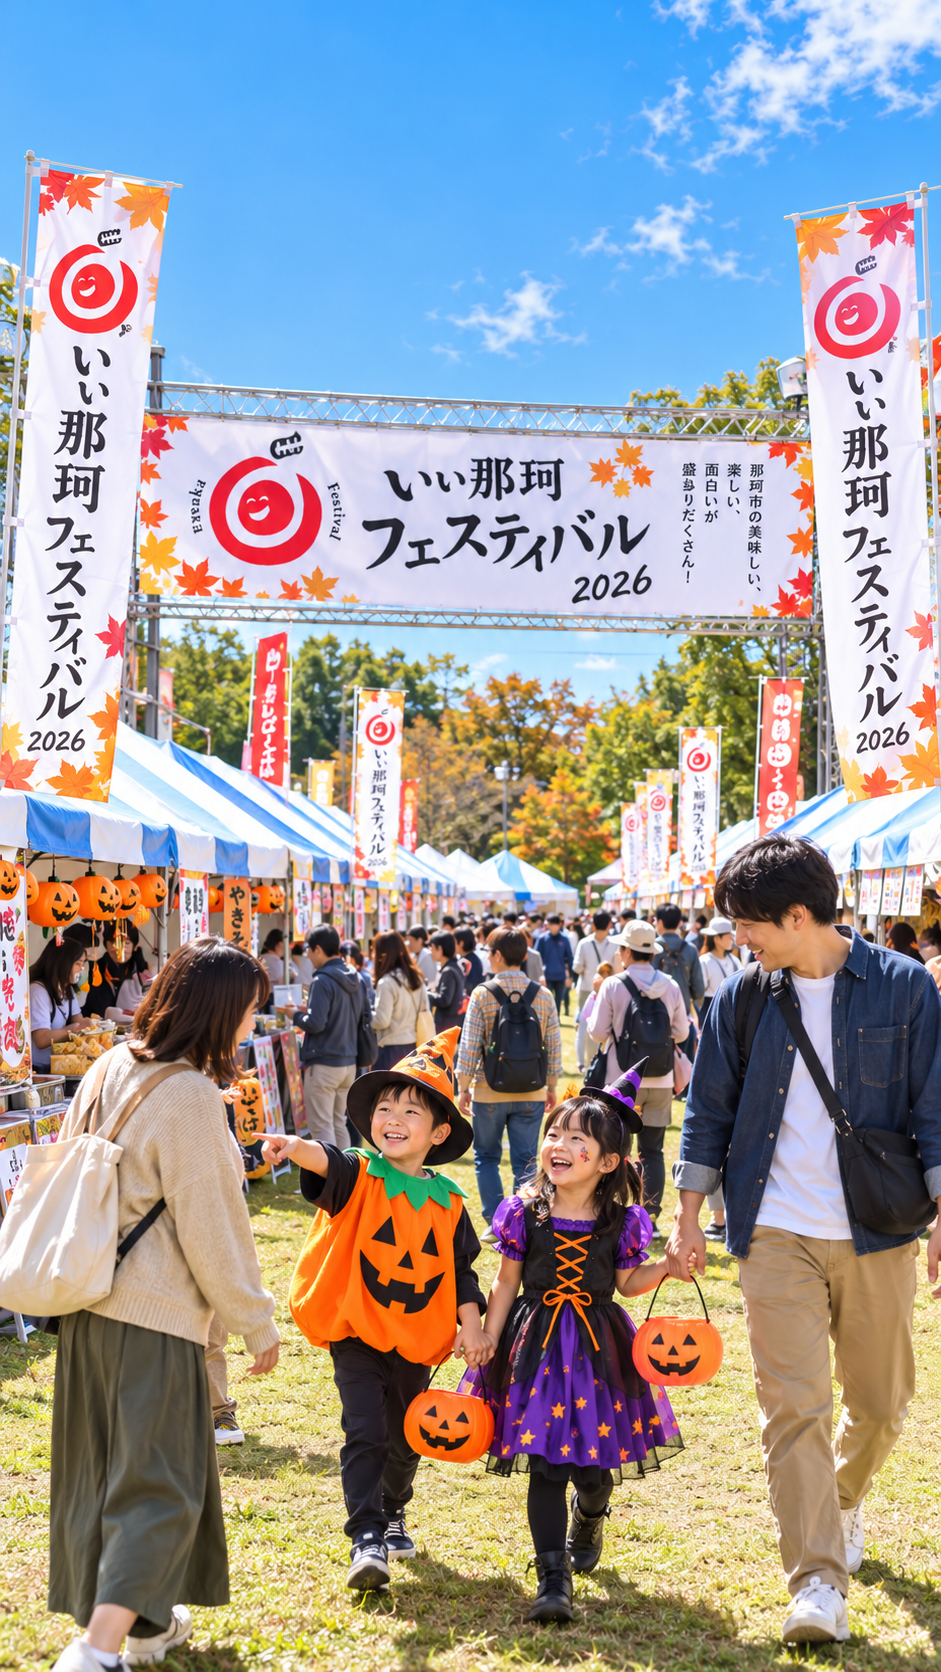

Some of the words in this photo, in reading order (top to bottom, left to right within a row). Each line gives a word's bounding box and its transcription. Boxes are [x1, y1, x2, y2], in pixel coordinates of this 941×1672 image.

[384, 456, 565, 502] いい那珂
[704, 463, 720, 523] 面白いが
[726, 462, 742, 515] 楽しい、
[36, 345, 111, 720] いい那珂フェスティバル
[327, 482, 346, 541] Festival
[362, 509, 651, 573] フェスティバル
[841, 368, 903, 722] いい那珂フェスティバル
[572, 564, 652, 604] 2026
[27, 730, 86, 753] 2026
[856, 722, 910, 754] 2026
